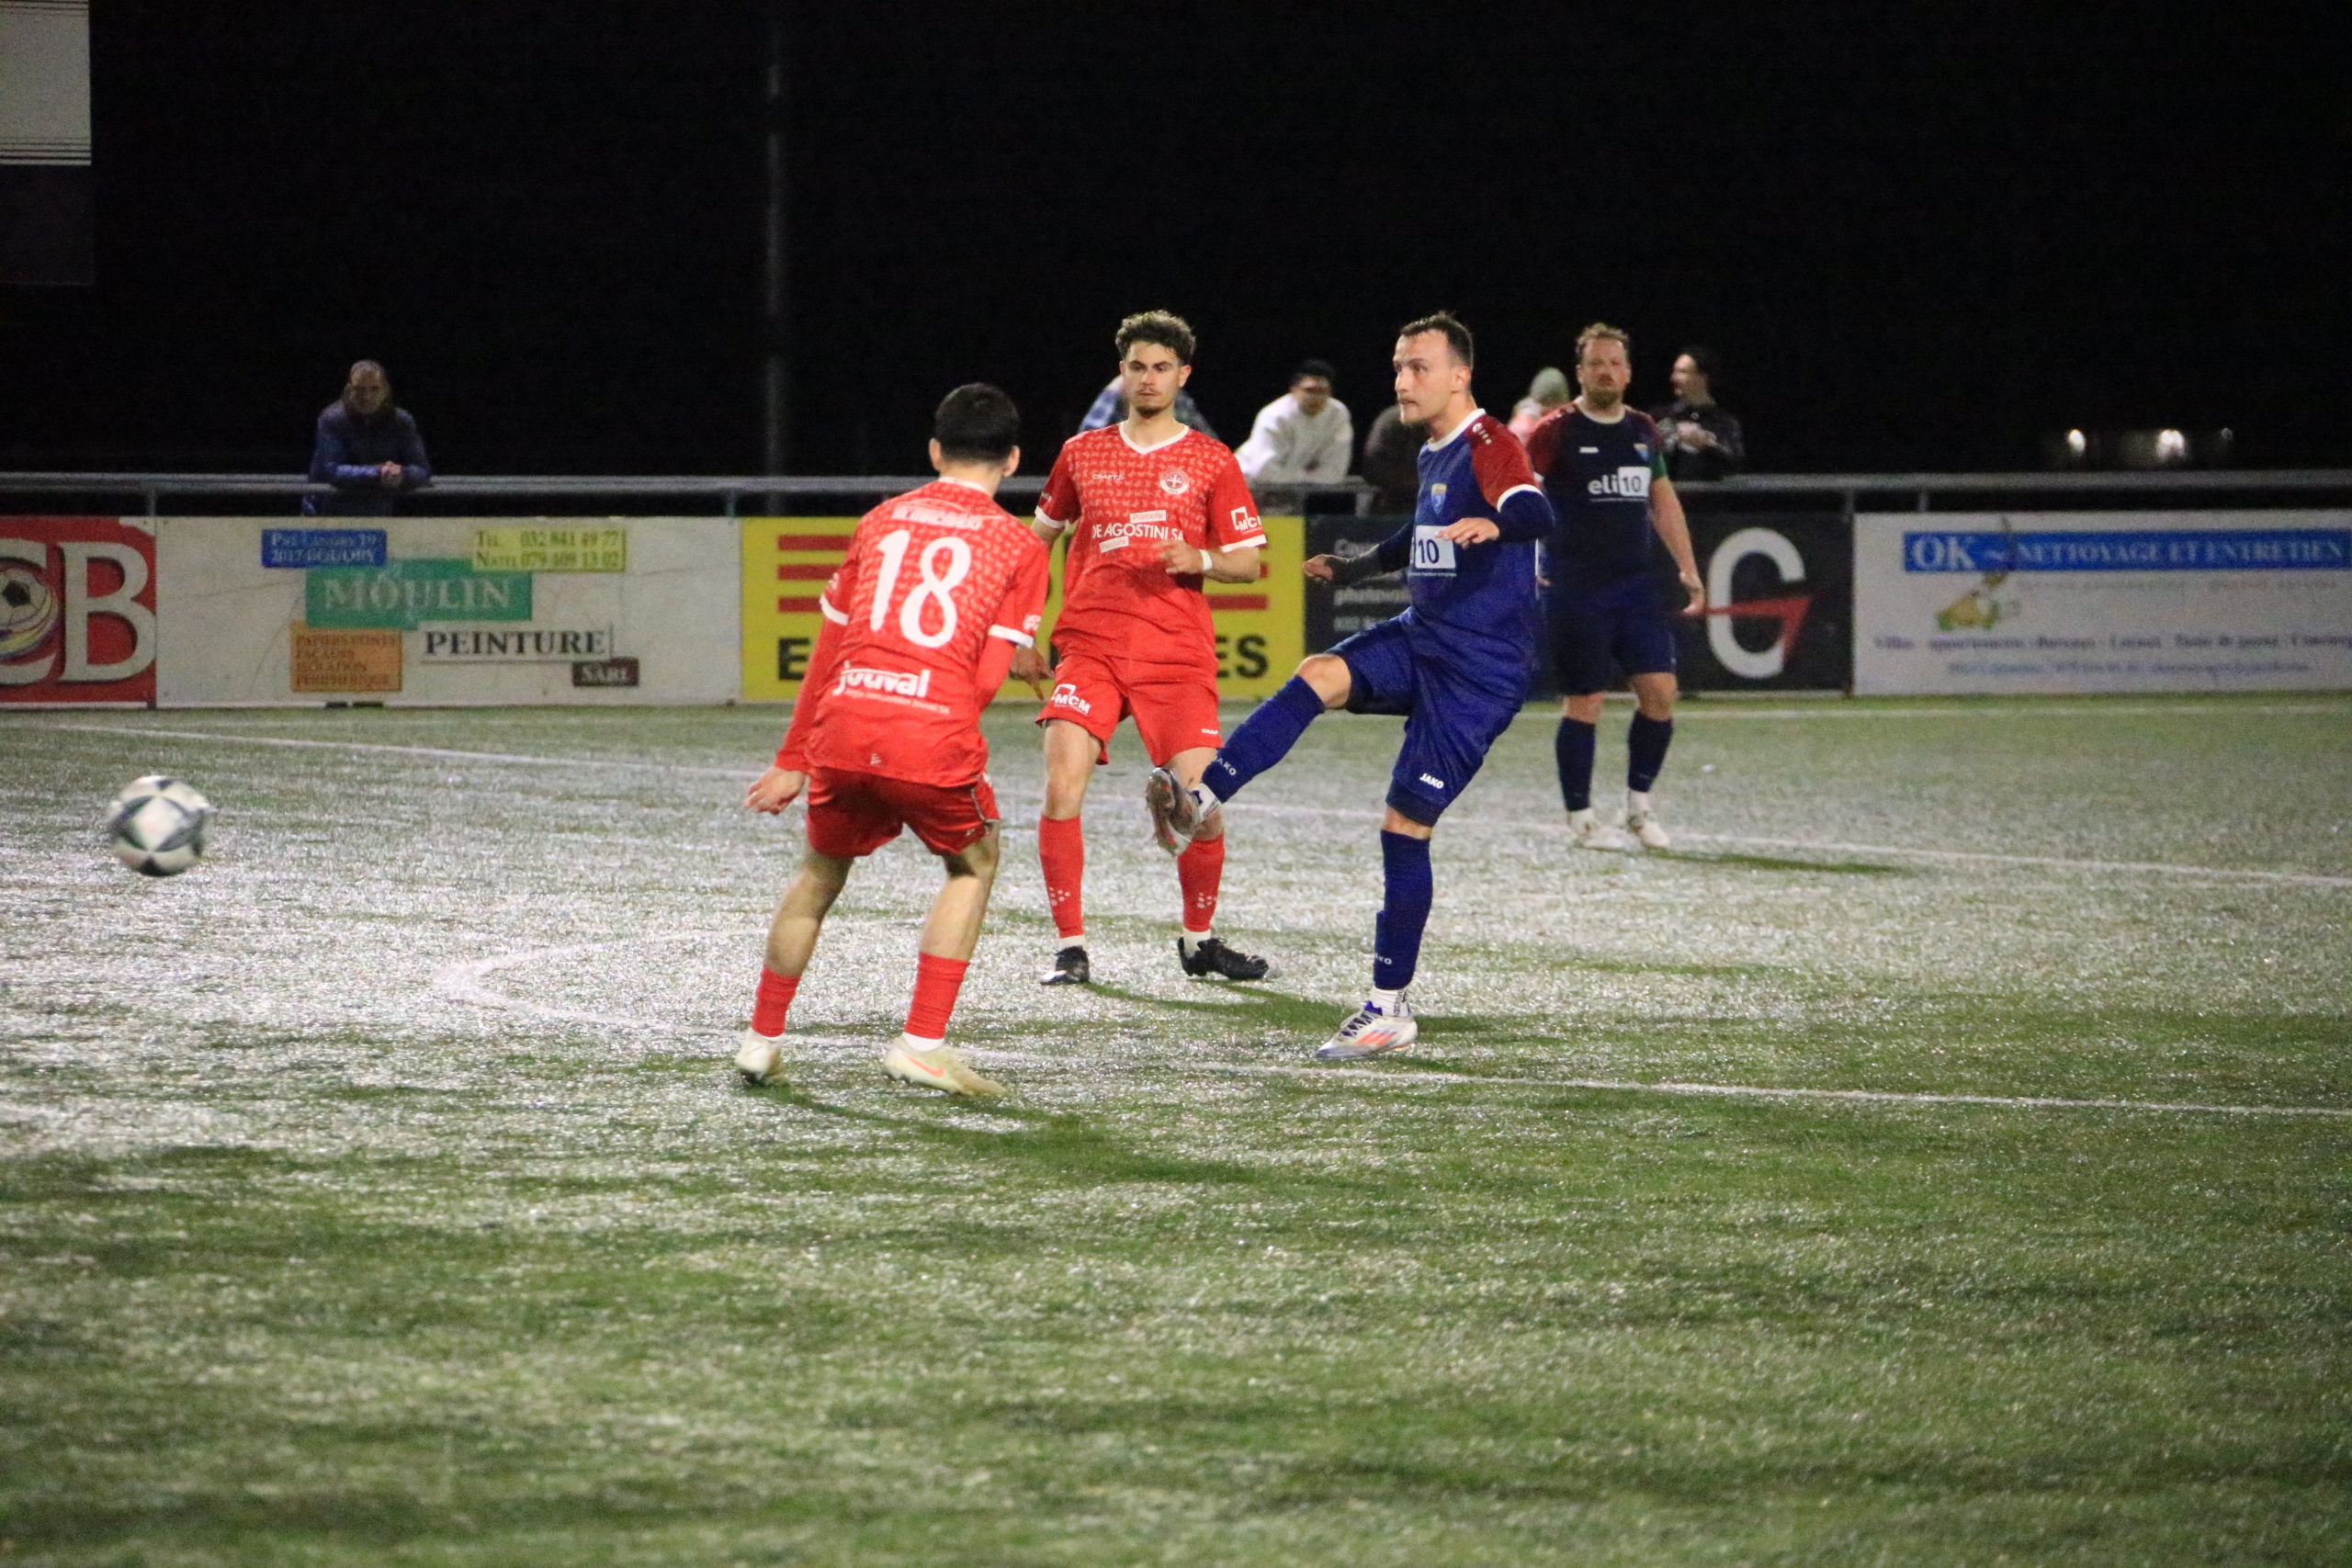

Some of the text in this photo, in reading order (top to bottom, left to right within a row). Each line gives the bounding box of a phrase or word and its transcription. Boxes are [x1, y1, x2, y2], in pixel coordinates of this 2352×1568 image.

[1588, 472, 1644, 495] eli10
[1104, 522, 1168, 540] AGOSTINI
[1912, 536, 1975, 569] OK
[2168, 540, 2199, 561] ET
[869, 529, 971, 648] 18
[425, 630, 605, 655] PEINTURE
[1054, 693, 1091, 715] MCM
[1419, 773, 1444, 789] JAKO
